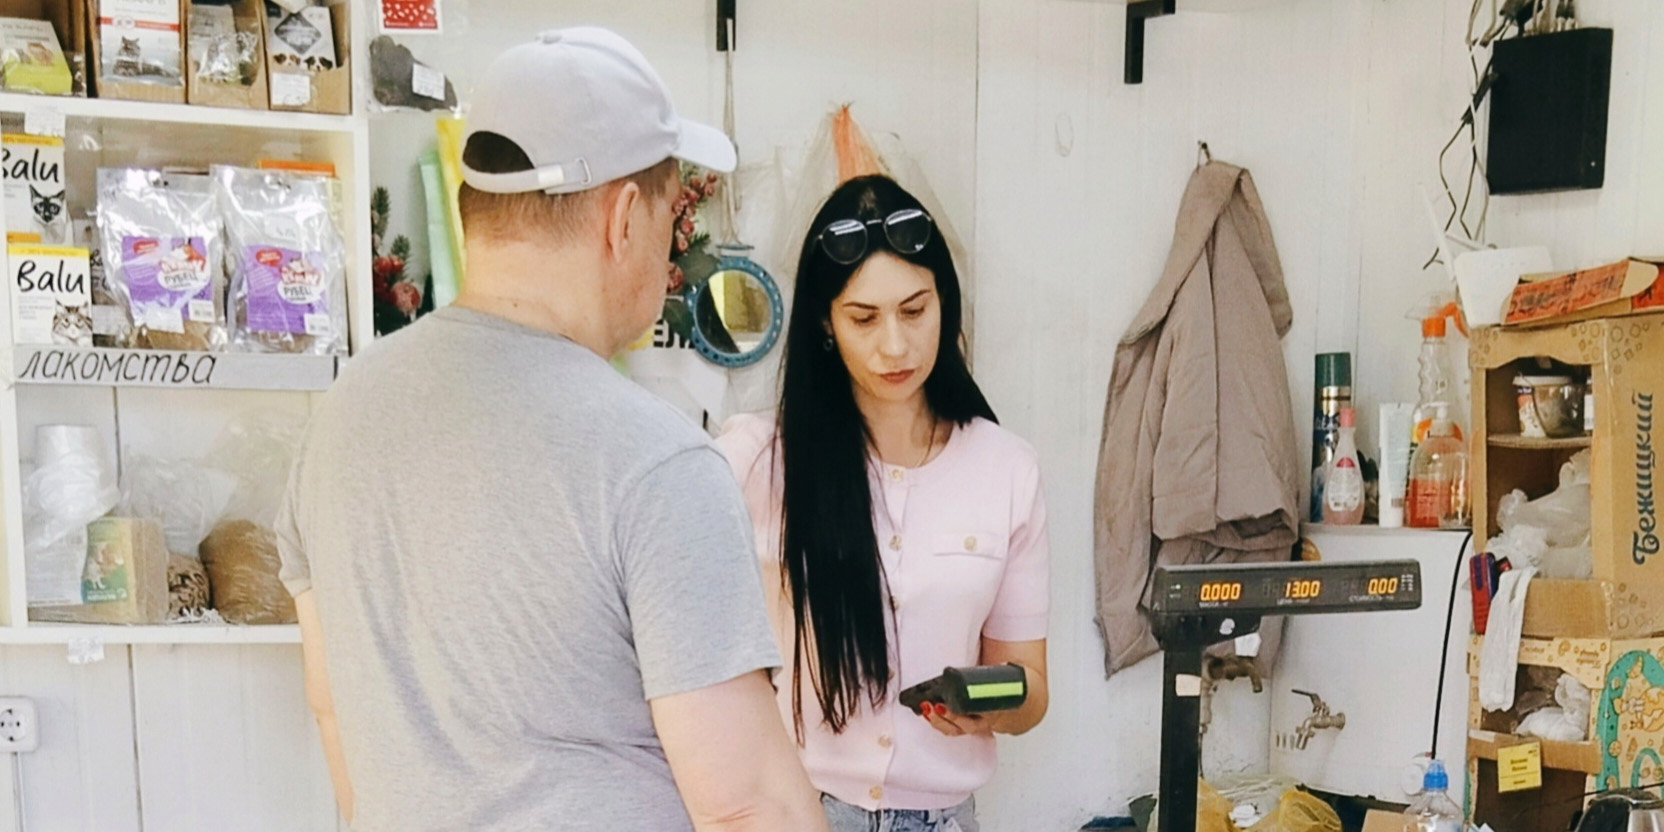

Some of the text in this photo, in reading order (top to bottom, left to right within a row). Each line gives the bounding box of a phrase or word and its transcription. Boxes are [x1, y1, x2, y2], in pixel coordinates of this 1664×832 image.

[17, 259, 85, 294] Balu
[653, 318, 696, 349] ЕЛ
[18, 351, 217, 384] лакомства
[1632, 389, 1660, 566] Бежицкий
